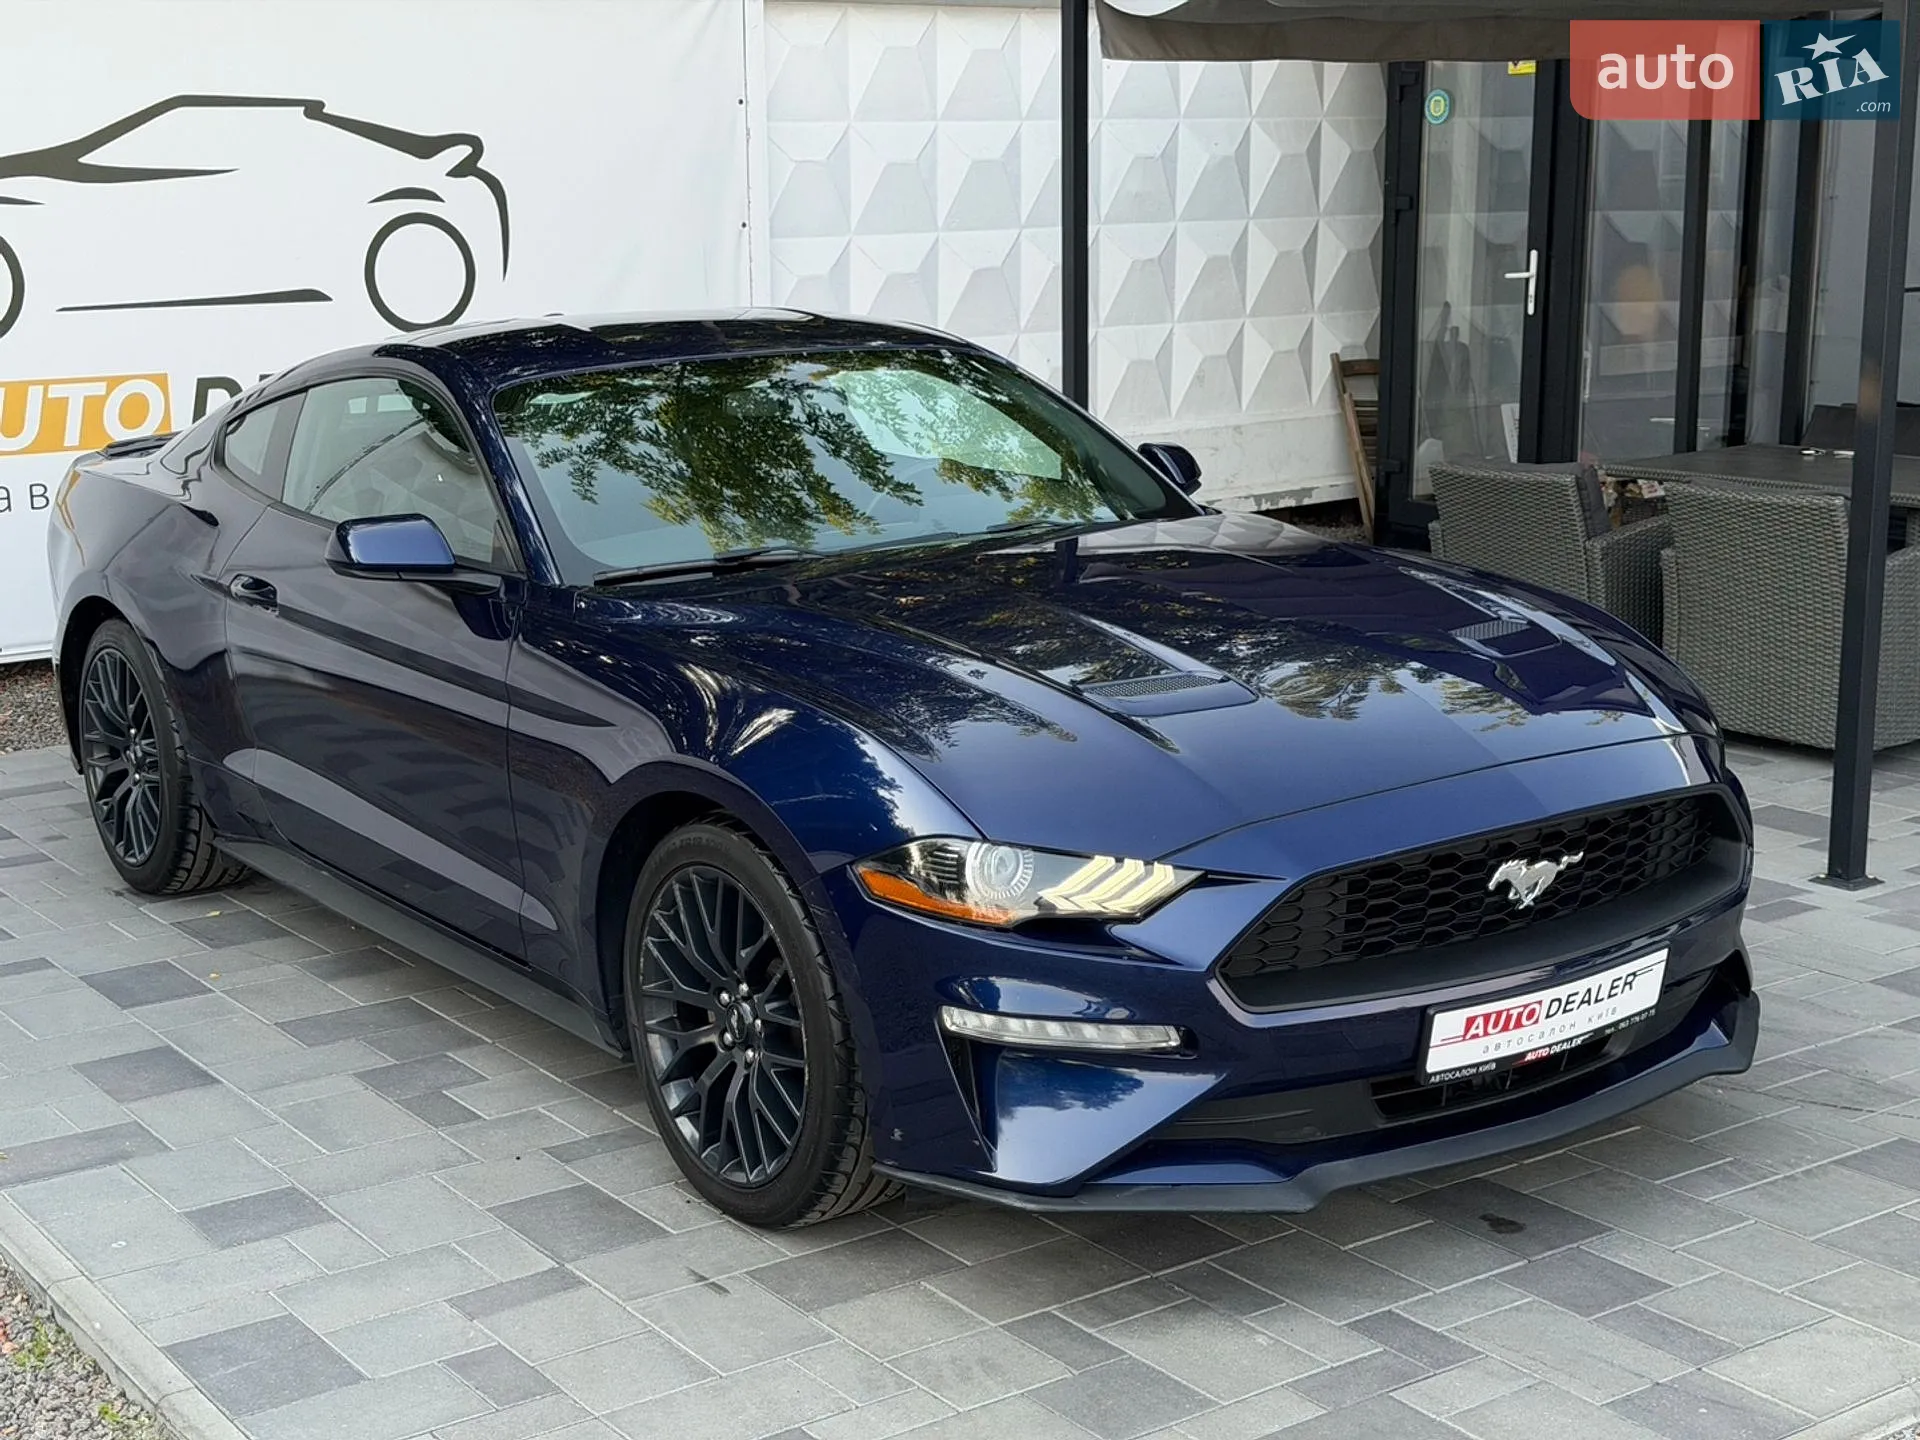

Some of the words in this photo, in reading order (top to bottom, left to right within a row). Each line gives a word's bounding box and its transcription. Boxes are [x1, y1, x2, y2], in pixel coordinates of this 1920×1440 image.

[1465, 1001, 1542, 1039] AUTO
[1544, 972, 1638, 1019] DEALER
[1524, 1048, 1549, 1061] AUTO
[1549, 1038, 1584, 1055] DEALER
[1429, 1067, 1477, 1084] АВТОСАЛОН
